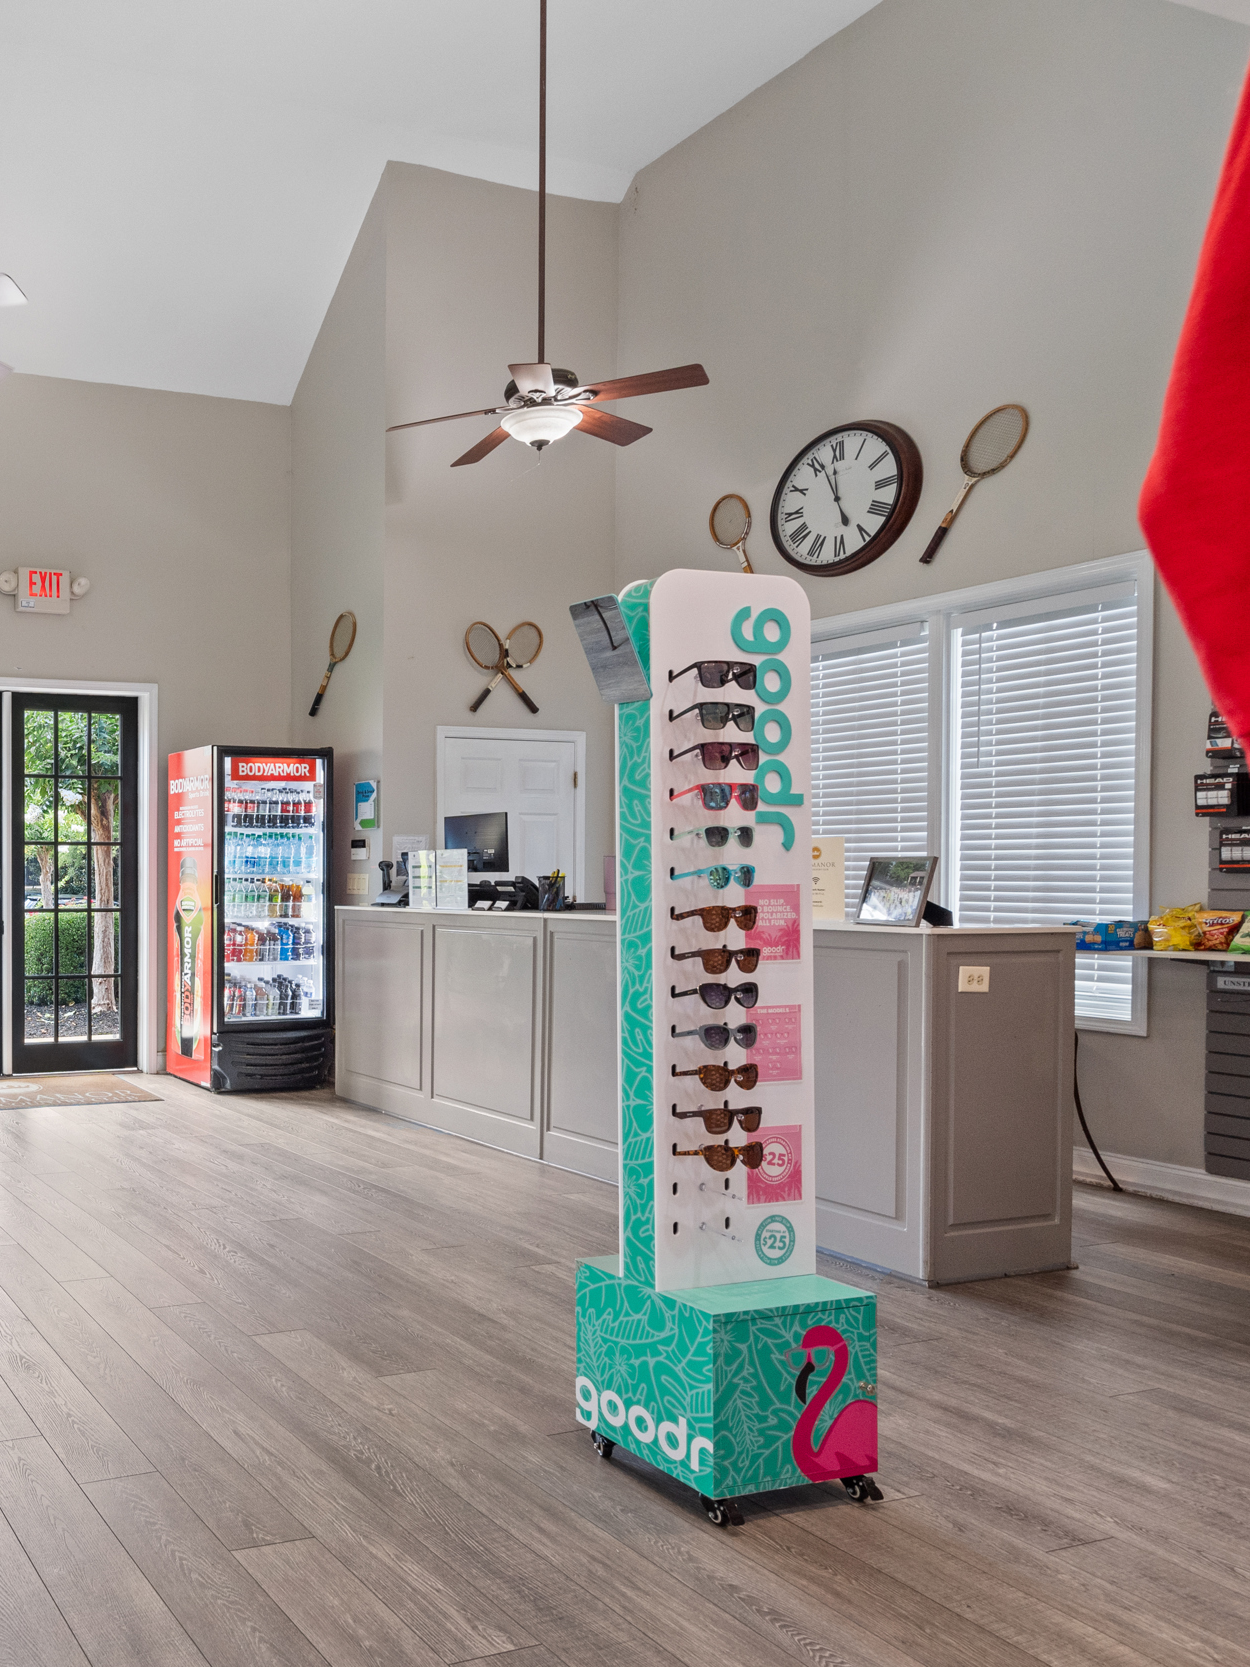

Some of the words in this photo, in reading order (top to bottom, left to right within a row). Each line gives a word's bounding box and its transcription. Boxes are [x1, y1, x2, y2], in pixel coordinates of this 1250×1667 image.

[29, 570, 63, 598] EXIT
[730, 606, 804, 851] goodr
[238, 763, 309, 776] BODYARMOR
[170, 774, 210, 795] BODYARMOR
[174, 810, 204, 819] ELECTROLYTES
[174, 824, 204, 833] ANTIOXIDANTS
[181, 838, 204, 847] ARTIFICIAL
[762, 946, 785, 956] goodr
[184, 926, 192, 1025] BODYARMOR
[0, 1089, 143, 1103] MANOR
[763, 1152, 786, 1168] $25
[762, 1234, 787, 1251] $25
[576, 1375, 713, 1472] goodr
